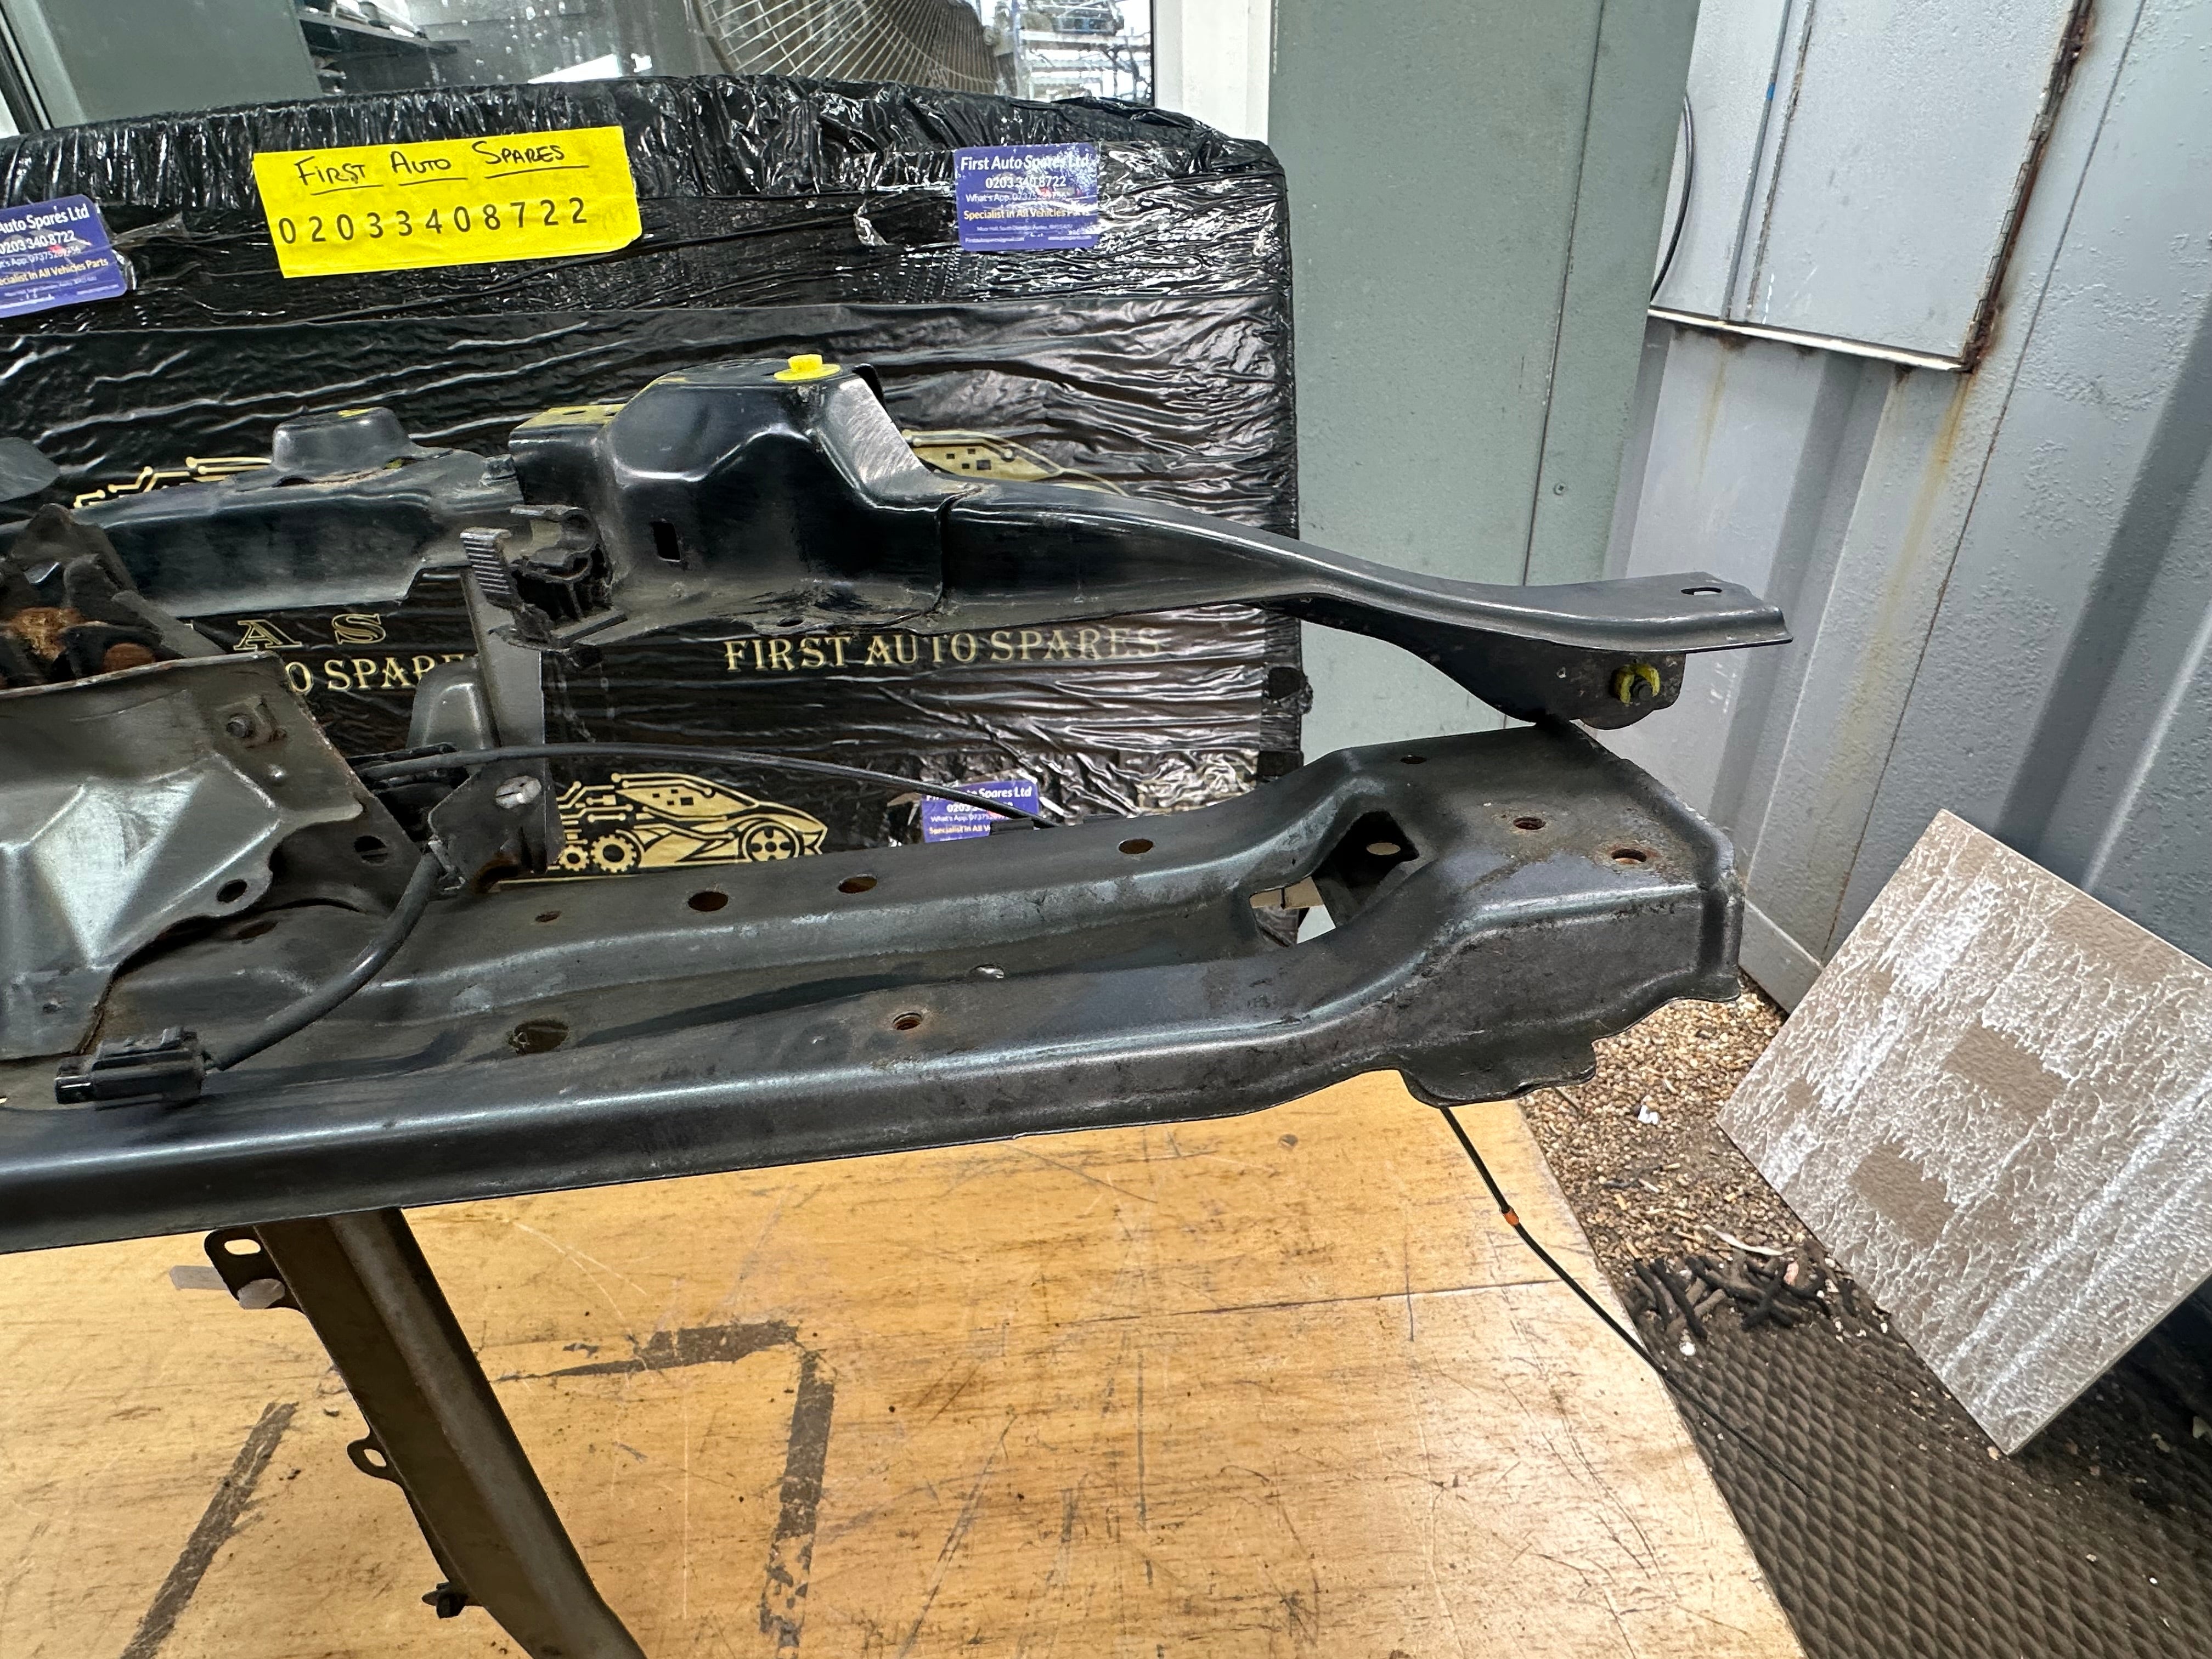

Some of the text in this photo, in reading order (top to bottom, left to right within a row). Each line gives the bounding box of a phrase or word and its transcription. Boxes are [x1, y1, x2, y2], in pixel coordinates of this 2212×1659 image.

[391, 151, 453, 174] AUTO
[472, 140, 565, 165] SPARES
[961, 153, 1089, 172] First Auto Spares Ltd
[985, 176, 1066, 189] 0203 340 8722
[26, 211, 69, 230] Spares
[67, 203, 90, 222] Ltd
[279, 196, 587, 244] 02033408722
[964, 208, 1005, 221] Specialist
[1017, 208, 1029, 218] All
[1031, 208, 1066, 218] Vehicles
[27, 233, 49, 250] 340
[49, 229, 76, 245] 8722
[0, 272, 29, 286] ecialist
[39, 268, 51, 278] All
[50, 262, 87, 276] Vehicles
[86, 258, 109, 269] Parts
[724, 627, 1160, 673] FIRST AUTO SPARES
[979, 788, 1014, 799] Spares
[1014, 786, 1032, 798] Ltd
[929, 825, 963, 834] Specialist
